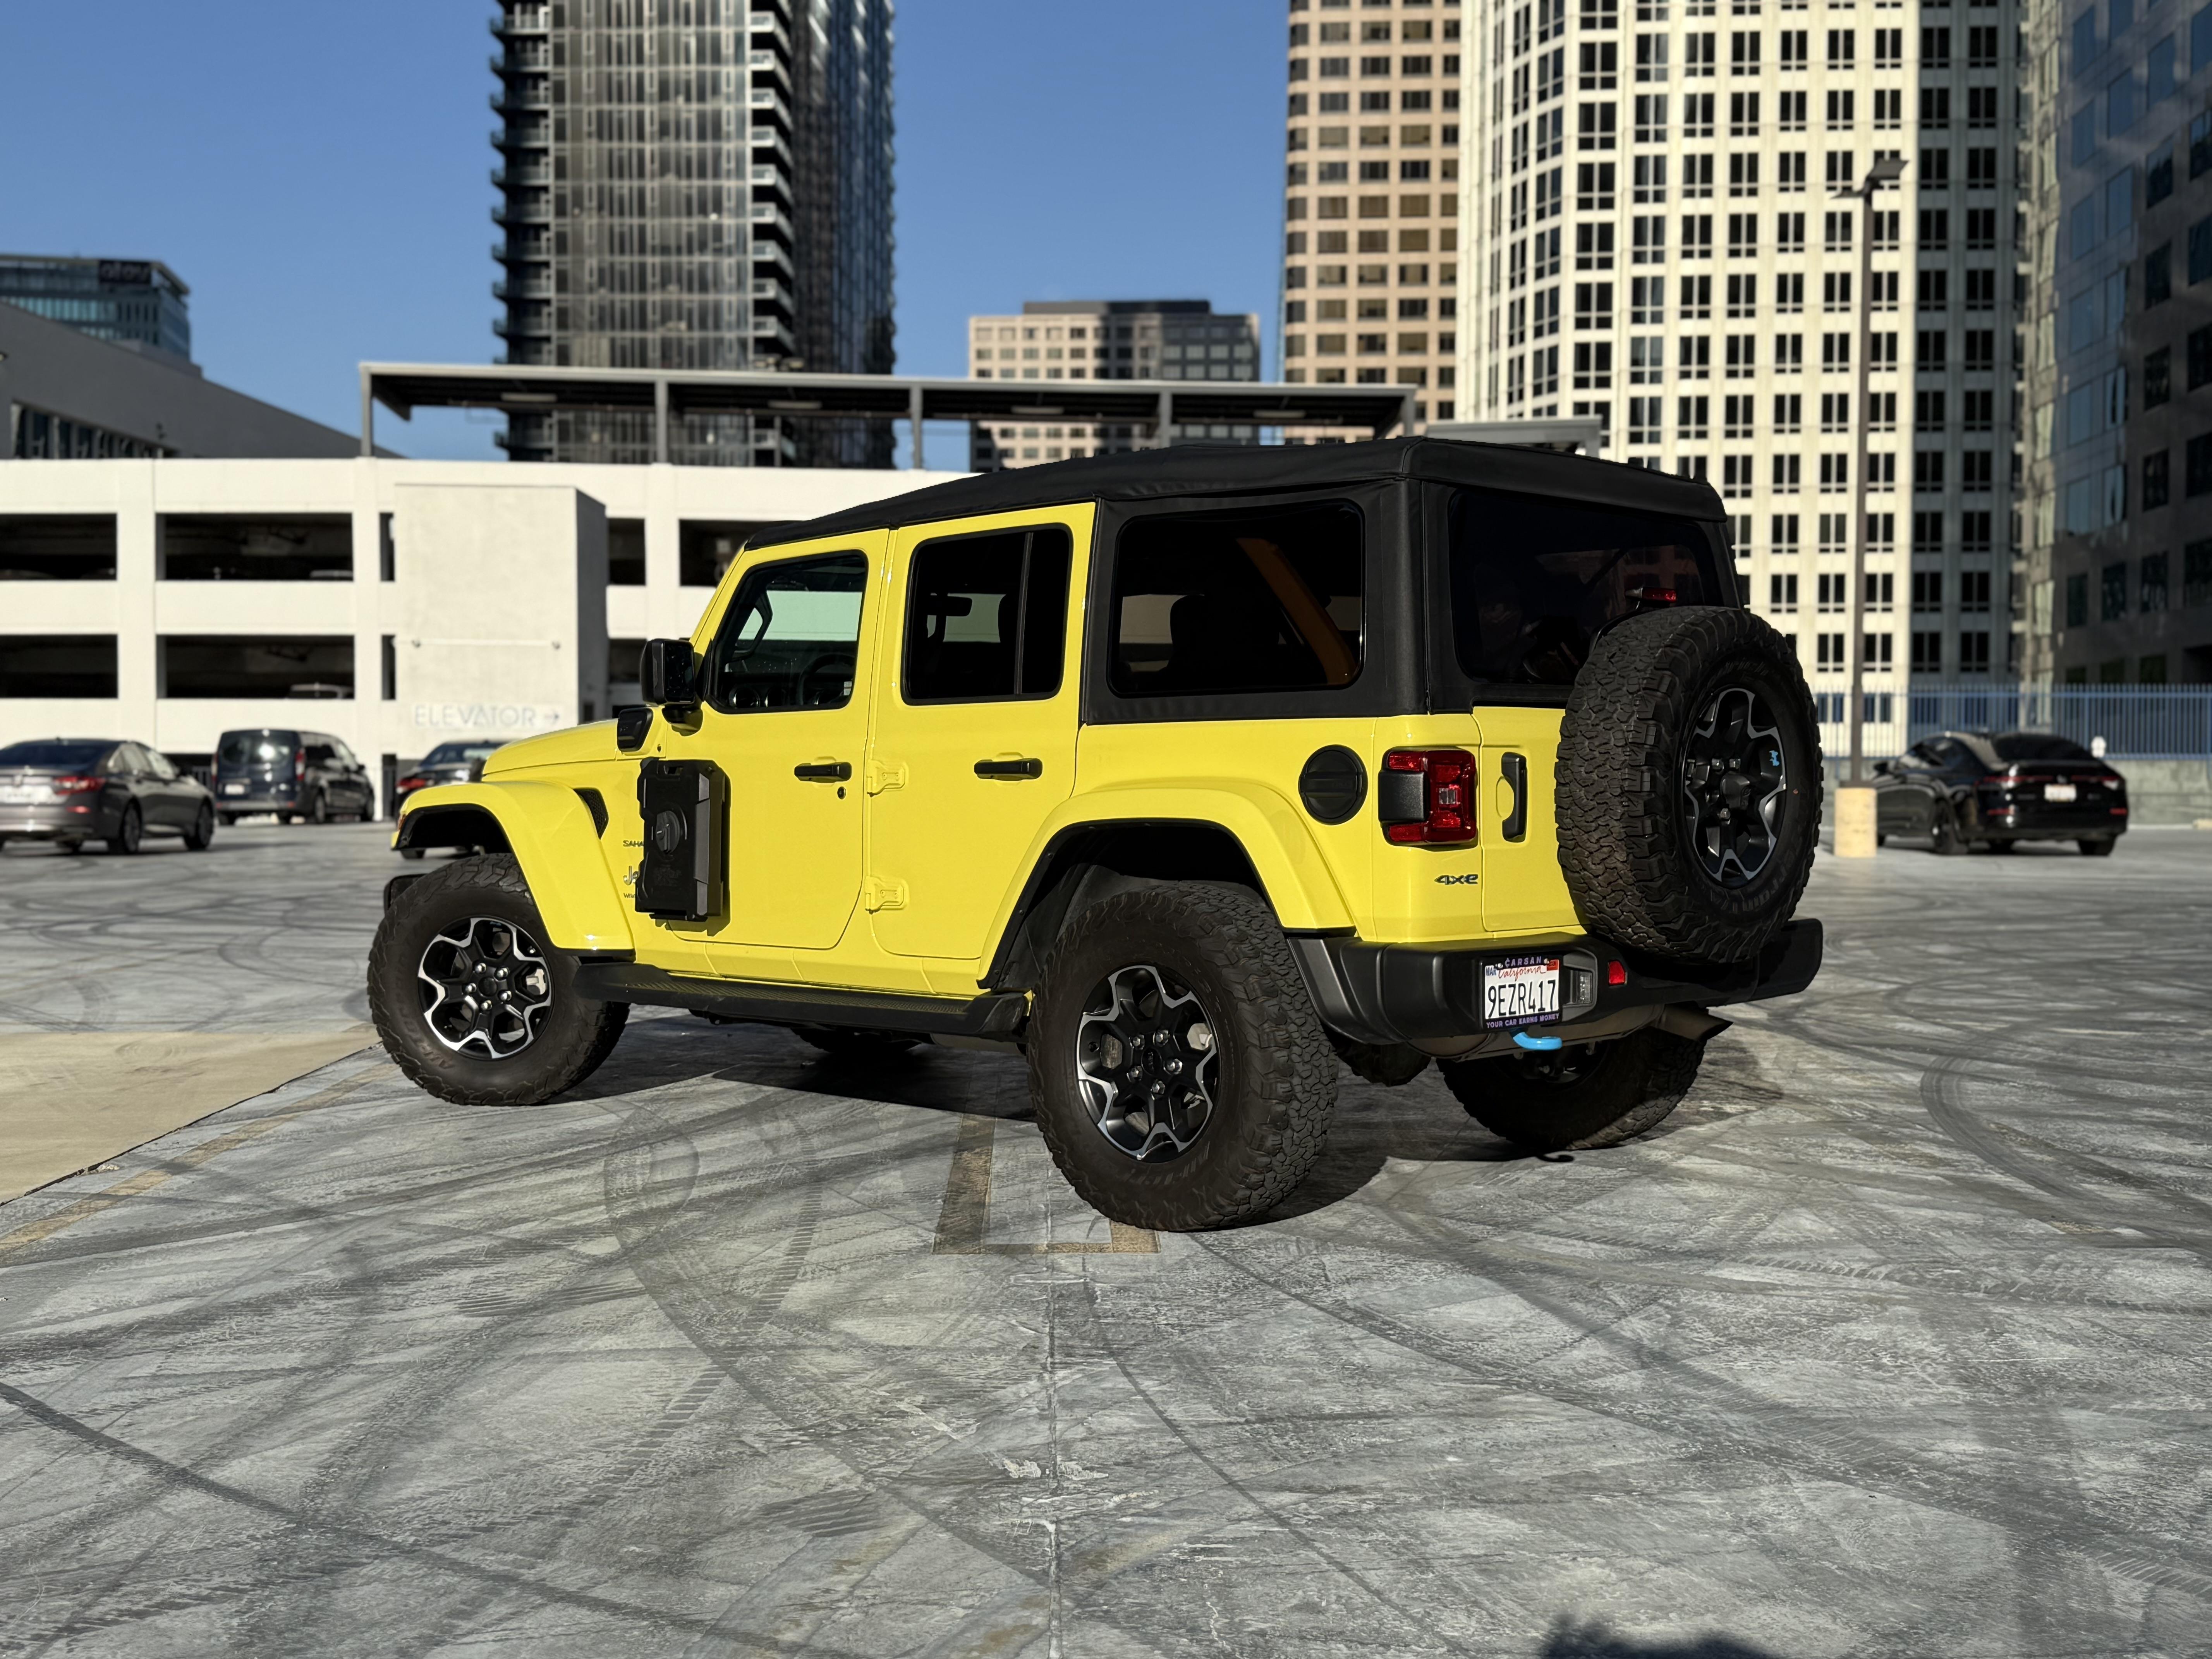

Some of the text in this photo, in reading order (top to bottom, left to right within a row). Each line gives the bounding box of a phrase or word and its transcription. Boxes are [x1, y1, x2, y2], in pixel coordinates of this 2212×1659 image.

[415, 705, 537, 727] ELEVATOR
[1434, 874, 1479, 885] 4xe
[1504, 956, 1541, 967] CARSAN
[1488, 980, 1556, 1018] 9EZR417
[1486, 1020, 1503, 1029] YOUR
[1519, 1015, 1538, 1024] EARNS
[1540, 1013, 1559, 1022] MONEY
